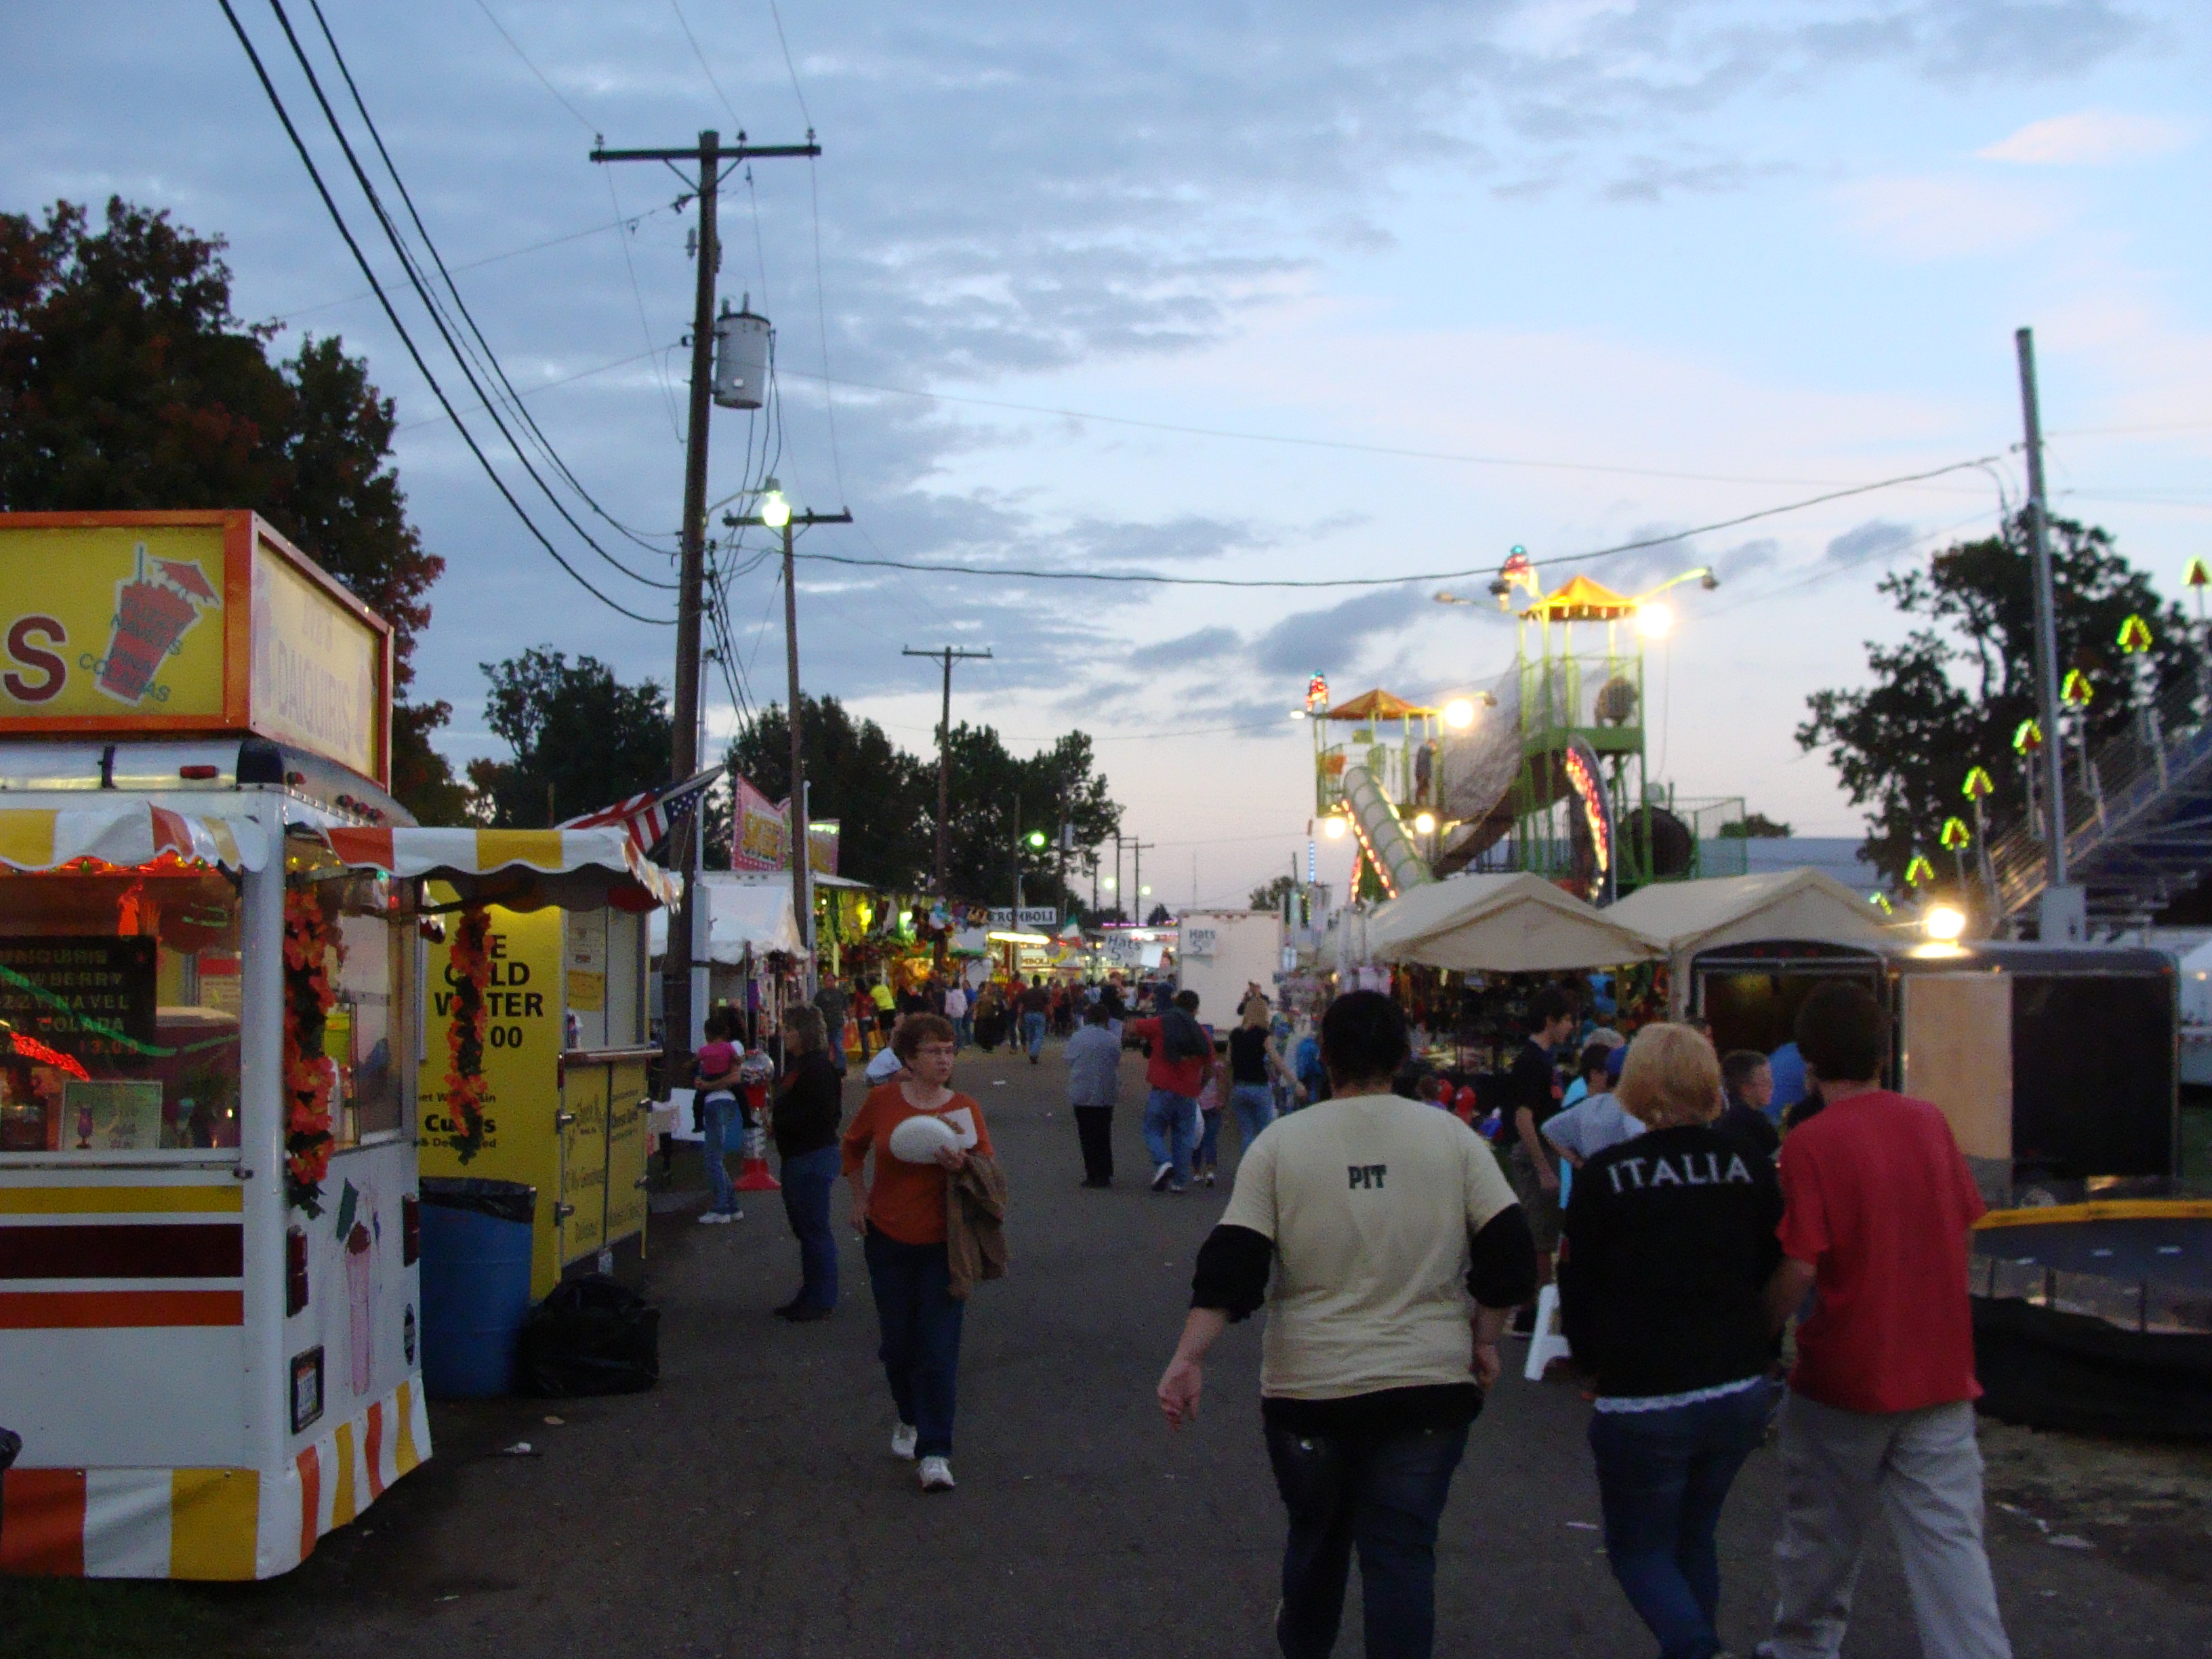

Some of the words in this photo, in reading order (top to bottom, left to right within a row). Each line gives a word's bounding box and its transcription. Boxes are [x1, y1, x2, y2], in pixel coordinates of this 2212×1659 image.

[1107, 935, 1141, 951] Hats
[1347, 1164, 1387, 1189] PIT
[1607, 1153, 1754, 1193] ITALIA
